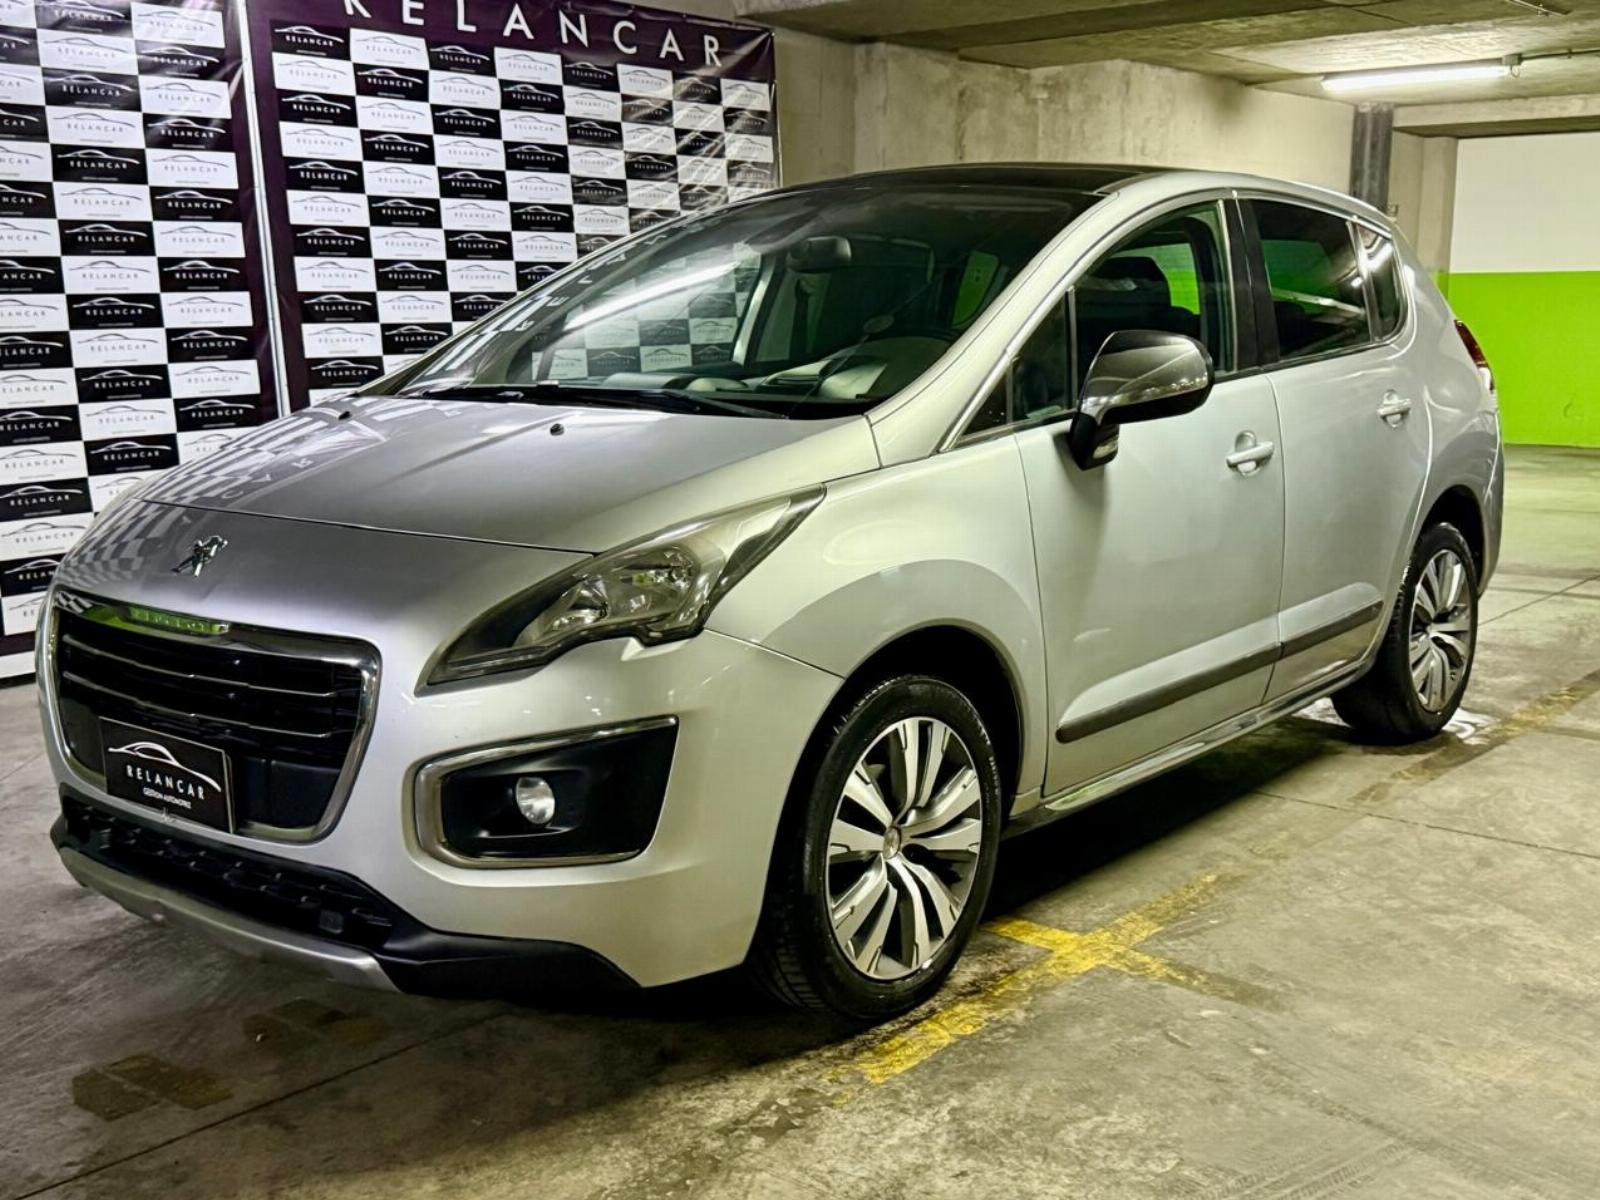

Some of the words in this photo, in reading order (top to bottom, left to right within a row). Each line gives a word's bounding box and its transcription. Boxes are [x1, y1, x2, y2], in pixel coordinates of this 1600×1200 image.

[285, 36, 333, 46] RELANCAR
[366, 45, 412, 55] RELANCAR
[153, 56, 208, 67] RELANCAR
[290, 70, 337, 79] RELANCAR
[368, 78, 412, 88] RELANCAR
[62, 85, 120, 96] RELANCAR
[293, 104, 340, 113] RELANCAR
[371, 112, 416, 120] RELANCAR
[67, 123, 123, 132] RELANCAR
[161, 129, 214, 138] RELANCAR
[297, 138, 344, 146] RELANCAR
[375, 144, 419, 152] RELANCAR
[70, 161, 127, 169] RELANCAR
[164, 165, 217, 173] RELANCAR
[300, 171, 347, 180] RELANCAR
[94, 380, 150, 388] RELANCAR
[192, 409, 244, 418] RELANCAR
[99, 415, 155, 424] RELANCAR
[104, 451, 159, 460] RELANCAR
[5, 459, 64, 468] RELANCAR
[11, 495, 69, 506] RELANCAR
[16, 532, 74, 543] RELANCAR
[126, 765, 204, 800] RELANCAR
